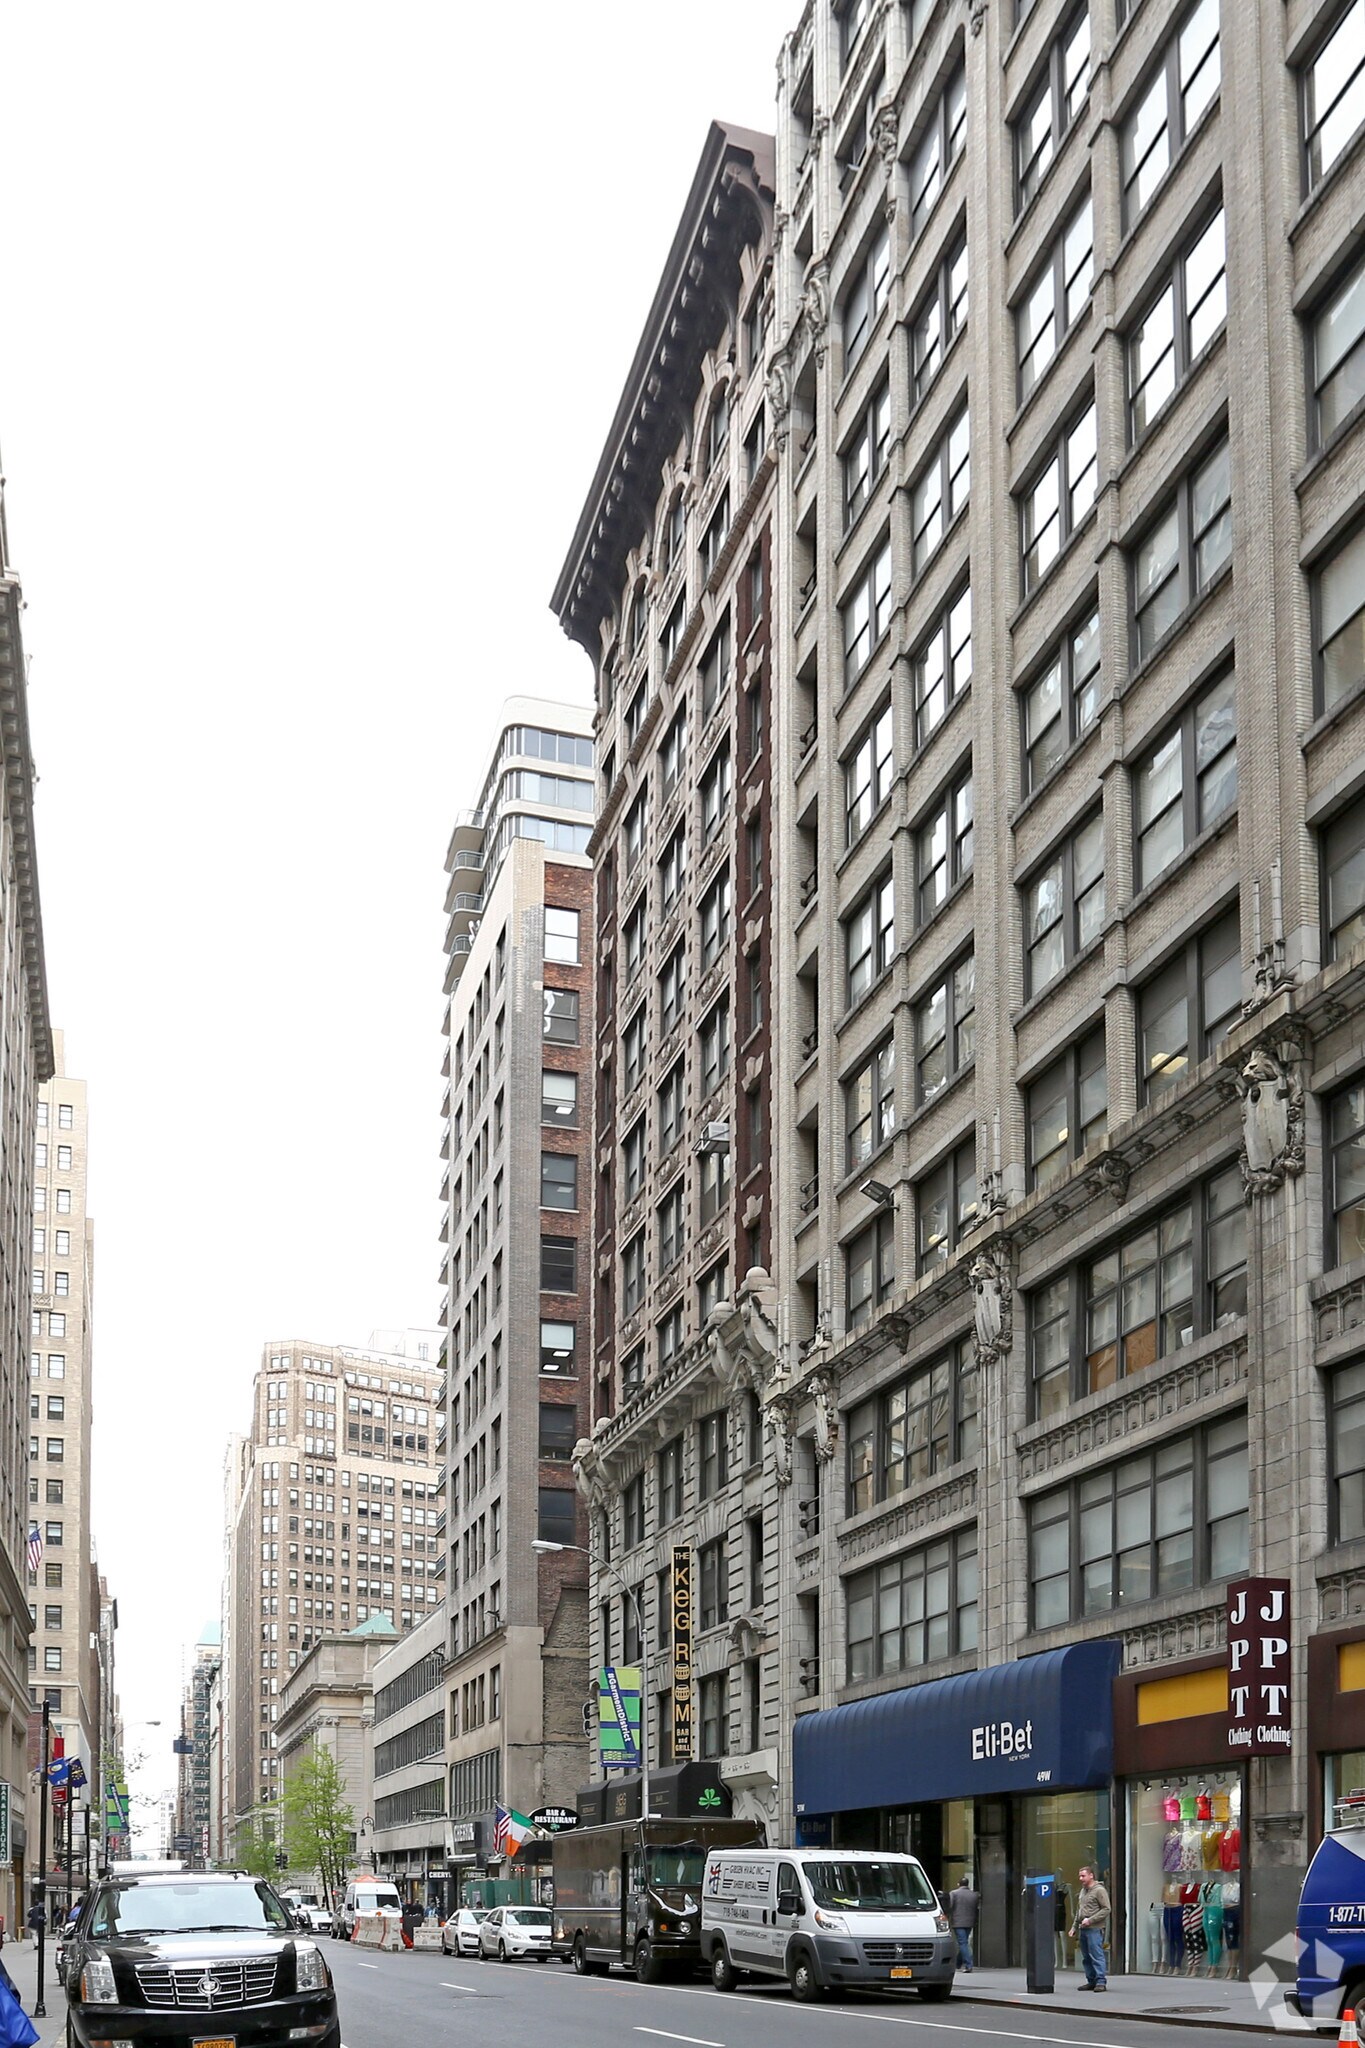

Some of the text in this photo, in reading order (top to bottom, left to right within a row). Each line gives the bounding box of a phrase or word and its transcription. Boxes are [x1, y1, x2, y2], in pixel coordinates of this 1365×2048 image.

[674, 1552, 690, 1560] THE
[607, 1673, 631, 1742] #GarmentDistrict
[676, 1728, 689, 1737] BAR
[1228, 1727, 1252, 1747] Clothing
[1257, 1725, 1292, 1748] Clothing
[972, 1720, 1033, 1760] Eli-Bet
[675, 1744, 690, 1752] GRILL
[1036, 1770, 1051, 1782] 49W
[545, 1809, 567, 1817] BAR &
[534, 1816, 578, 1825] RESTAURANT
[1041, 1884, 1050, 1897] P
